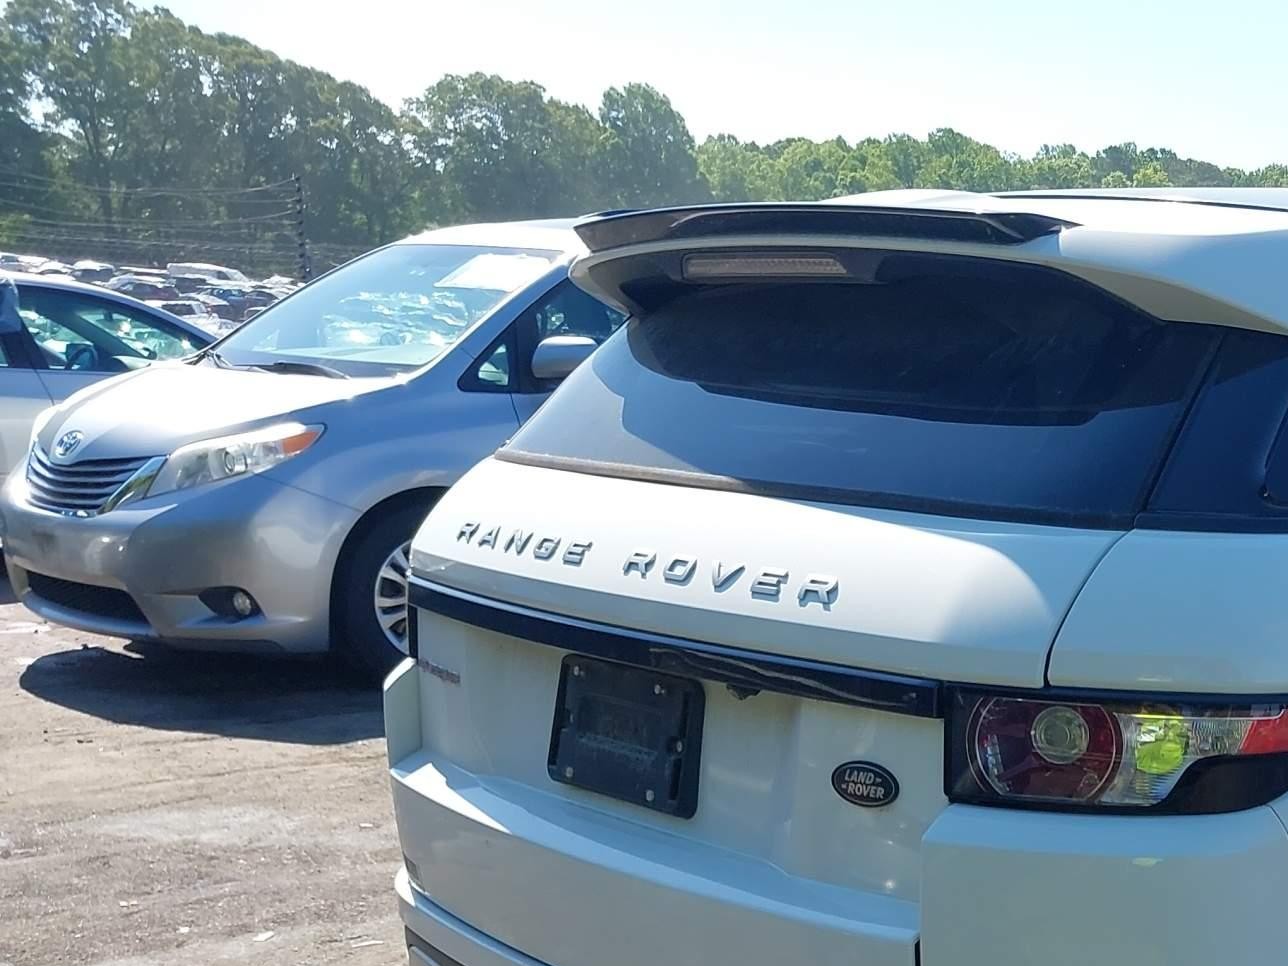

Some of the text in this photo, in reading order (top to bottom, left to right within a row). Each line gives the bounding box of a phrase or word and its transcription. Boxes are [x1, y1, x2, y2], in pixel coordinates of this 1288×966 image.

[456, 520, 840, 613] RANGE ROVER
[847, 782, 885, 799] ROVER
